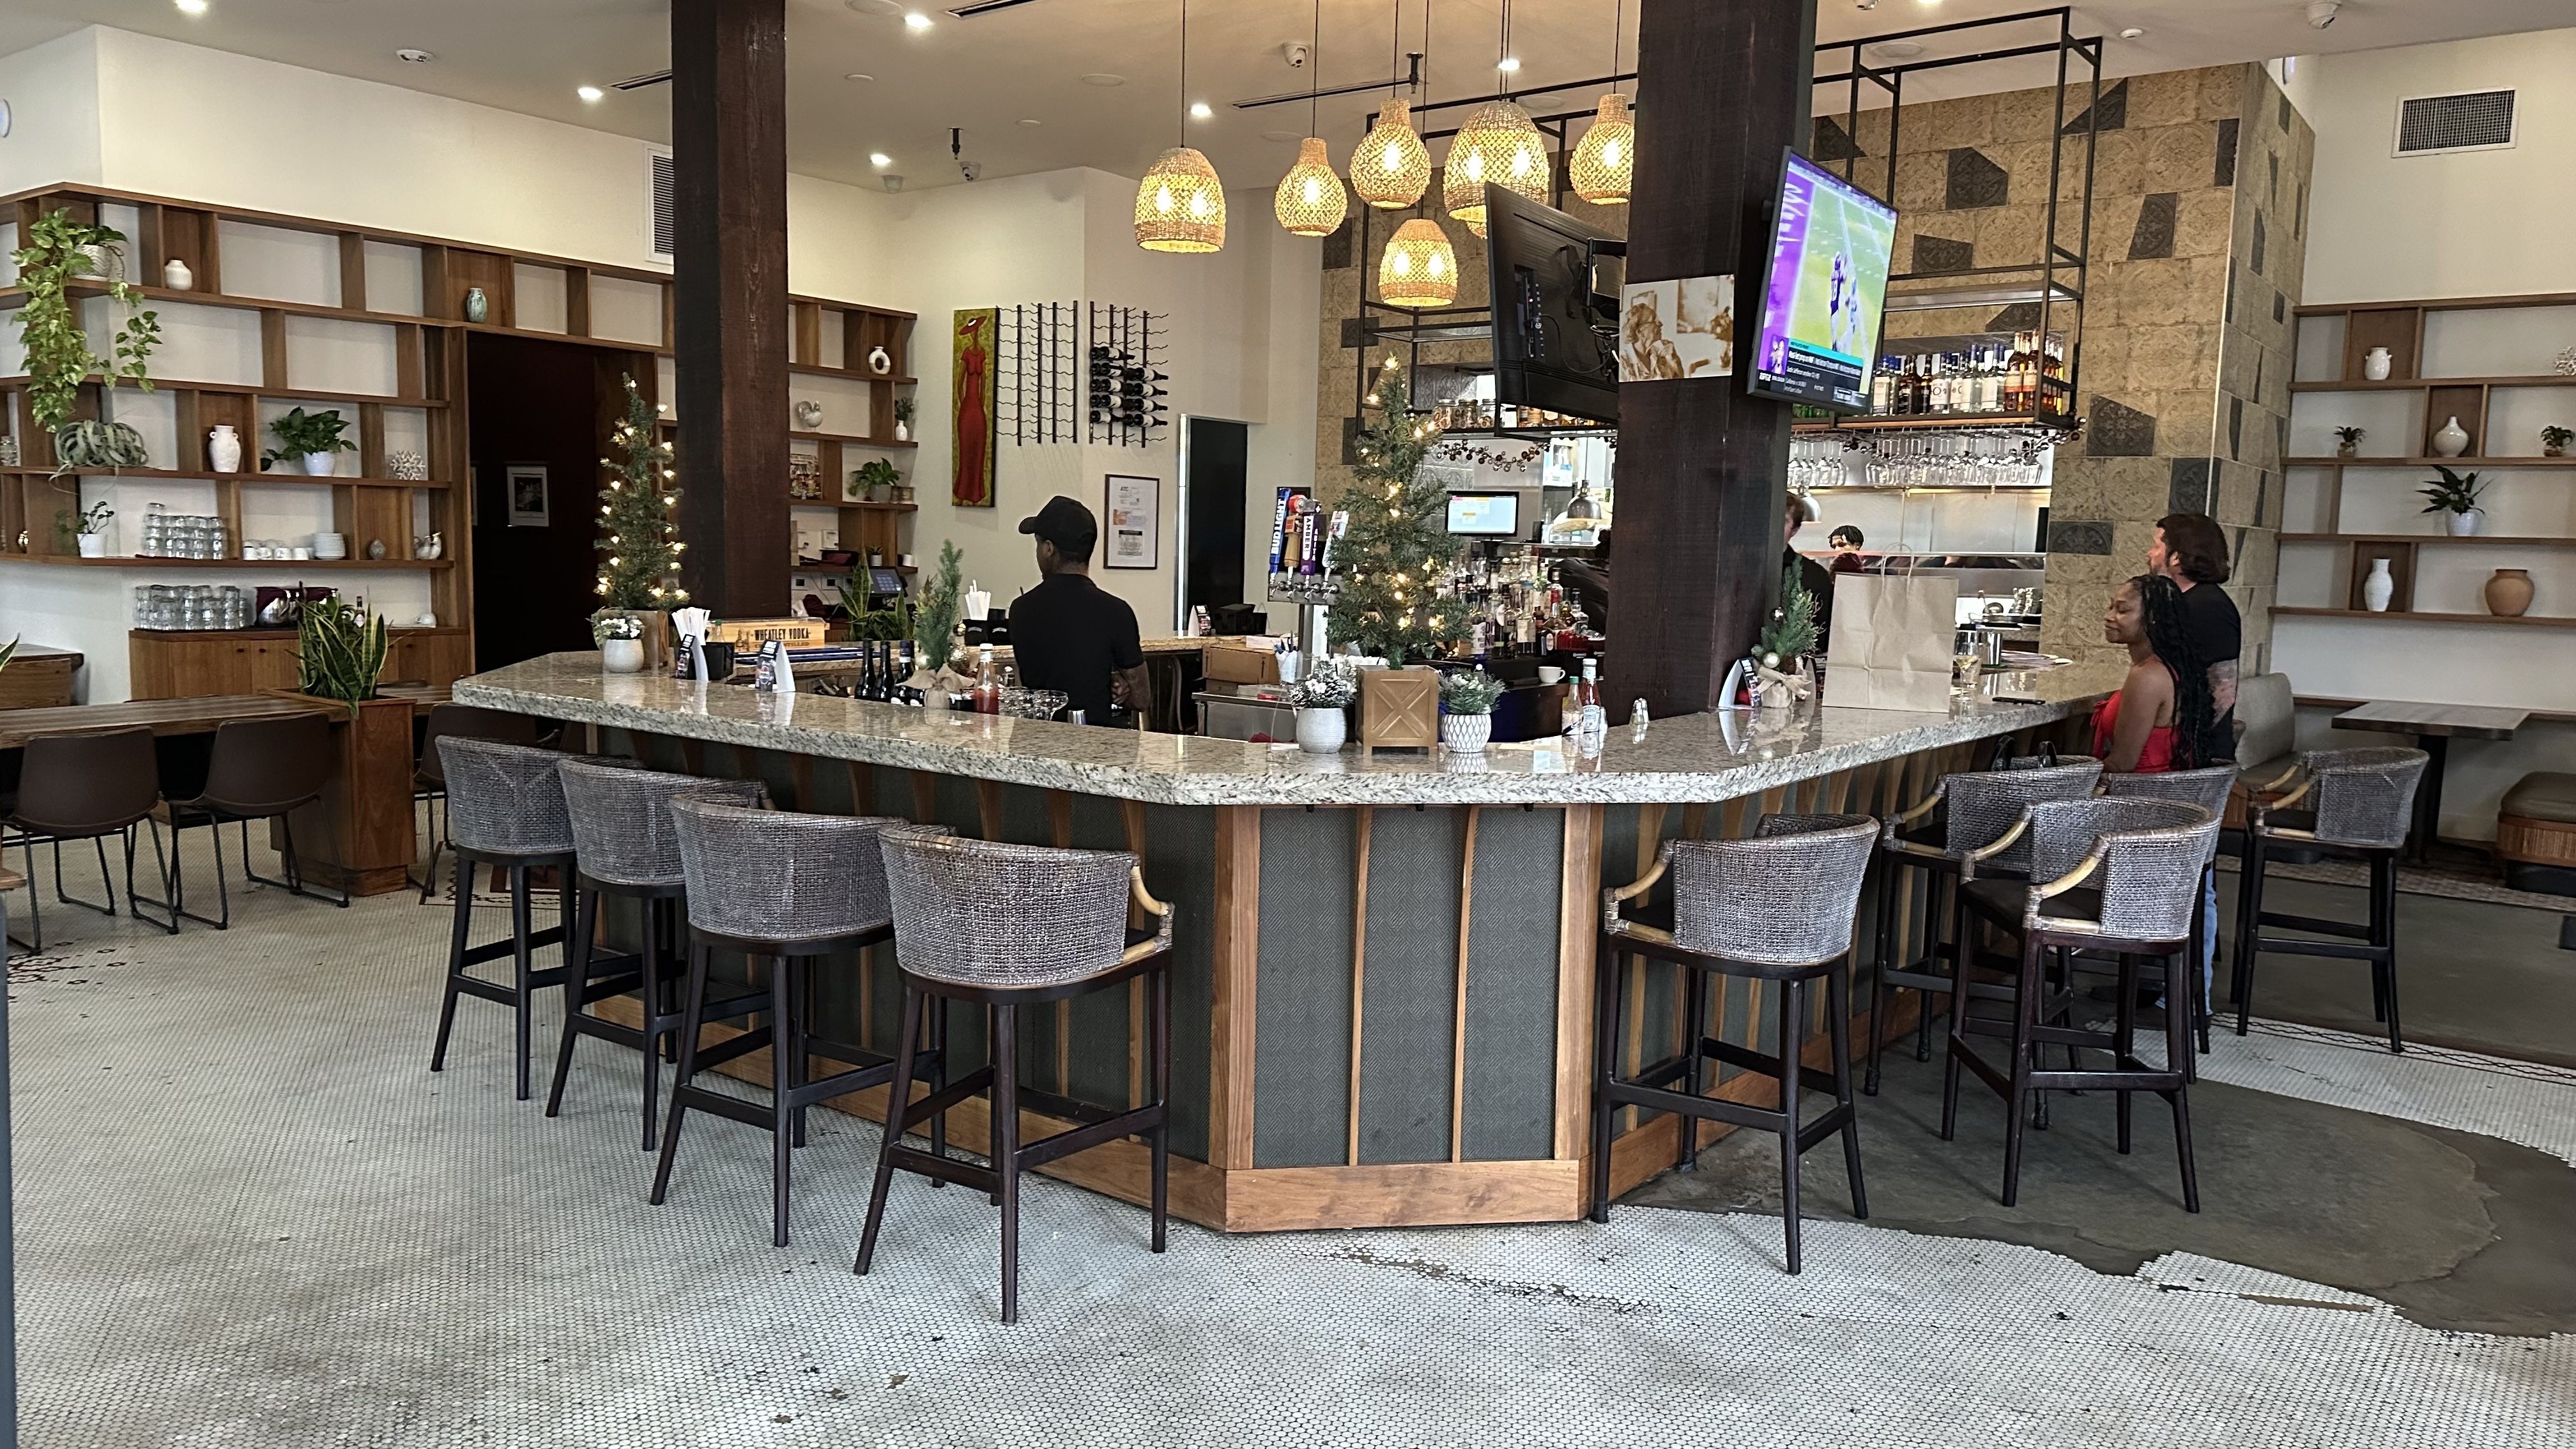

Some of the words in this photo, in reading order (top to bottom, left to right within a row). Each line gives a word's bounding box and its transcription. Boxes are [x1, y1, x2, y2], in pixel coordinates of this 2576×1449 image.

[1274, 499, 1287, 531] LIGHT
[1271, 531, 1281, 555] BUD
[755, 628, 786, 641] WHEATLEY
[789, 627, 809, 640] VODKA
